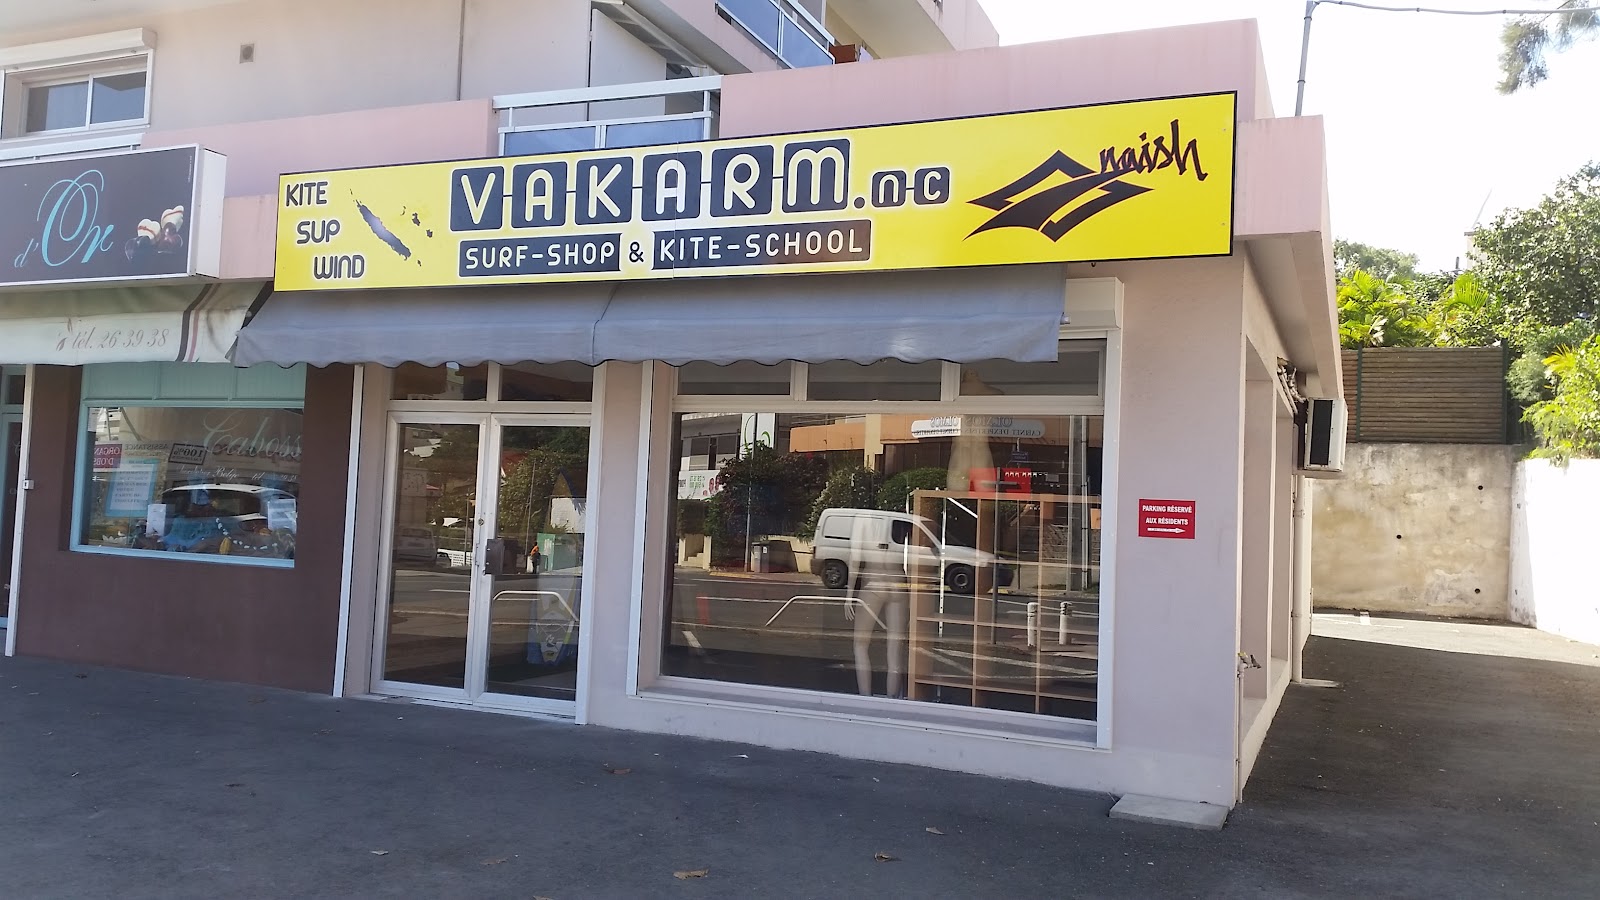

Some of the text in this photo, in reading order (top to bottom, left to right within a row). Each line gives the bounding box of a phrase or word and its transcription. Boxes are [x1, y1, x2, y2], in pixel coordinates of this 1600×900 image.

[1099, 119, 1208, 181] naish
[286, 181, 328, 207] KITE
[297, 219, 341, 244] SUP
[465, 228, 863, 270] SURF-SHOP & KITE-SCHOOL
[314, 254, 365, 279] WIND
[97, 330, 121, 349] 26
[122, 329, 145, 348] 39
[147, 328, 170, 348] 38
[1158, 516, 1189, 526] RÉSIDENTS
[1166, 504, 1193, 514] RÉSERVÉ
